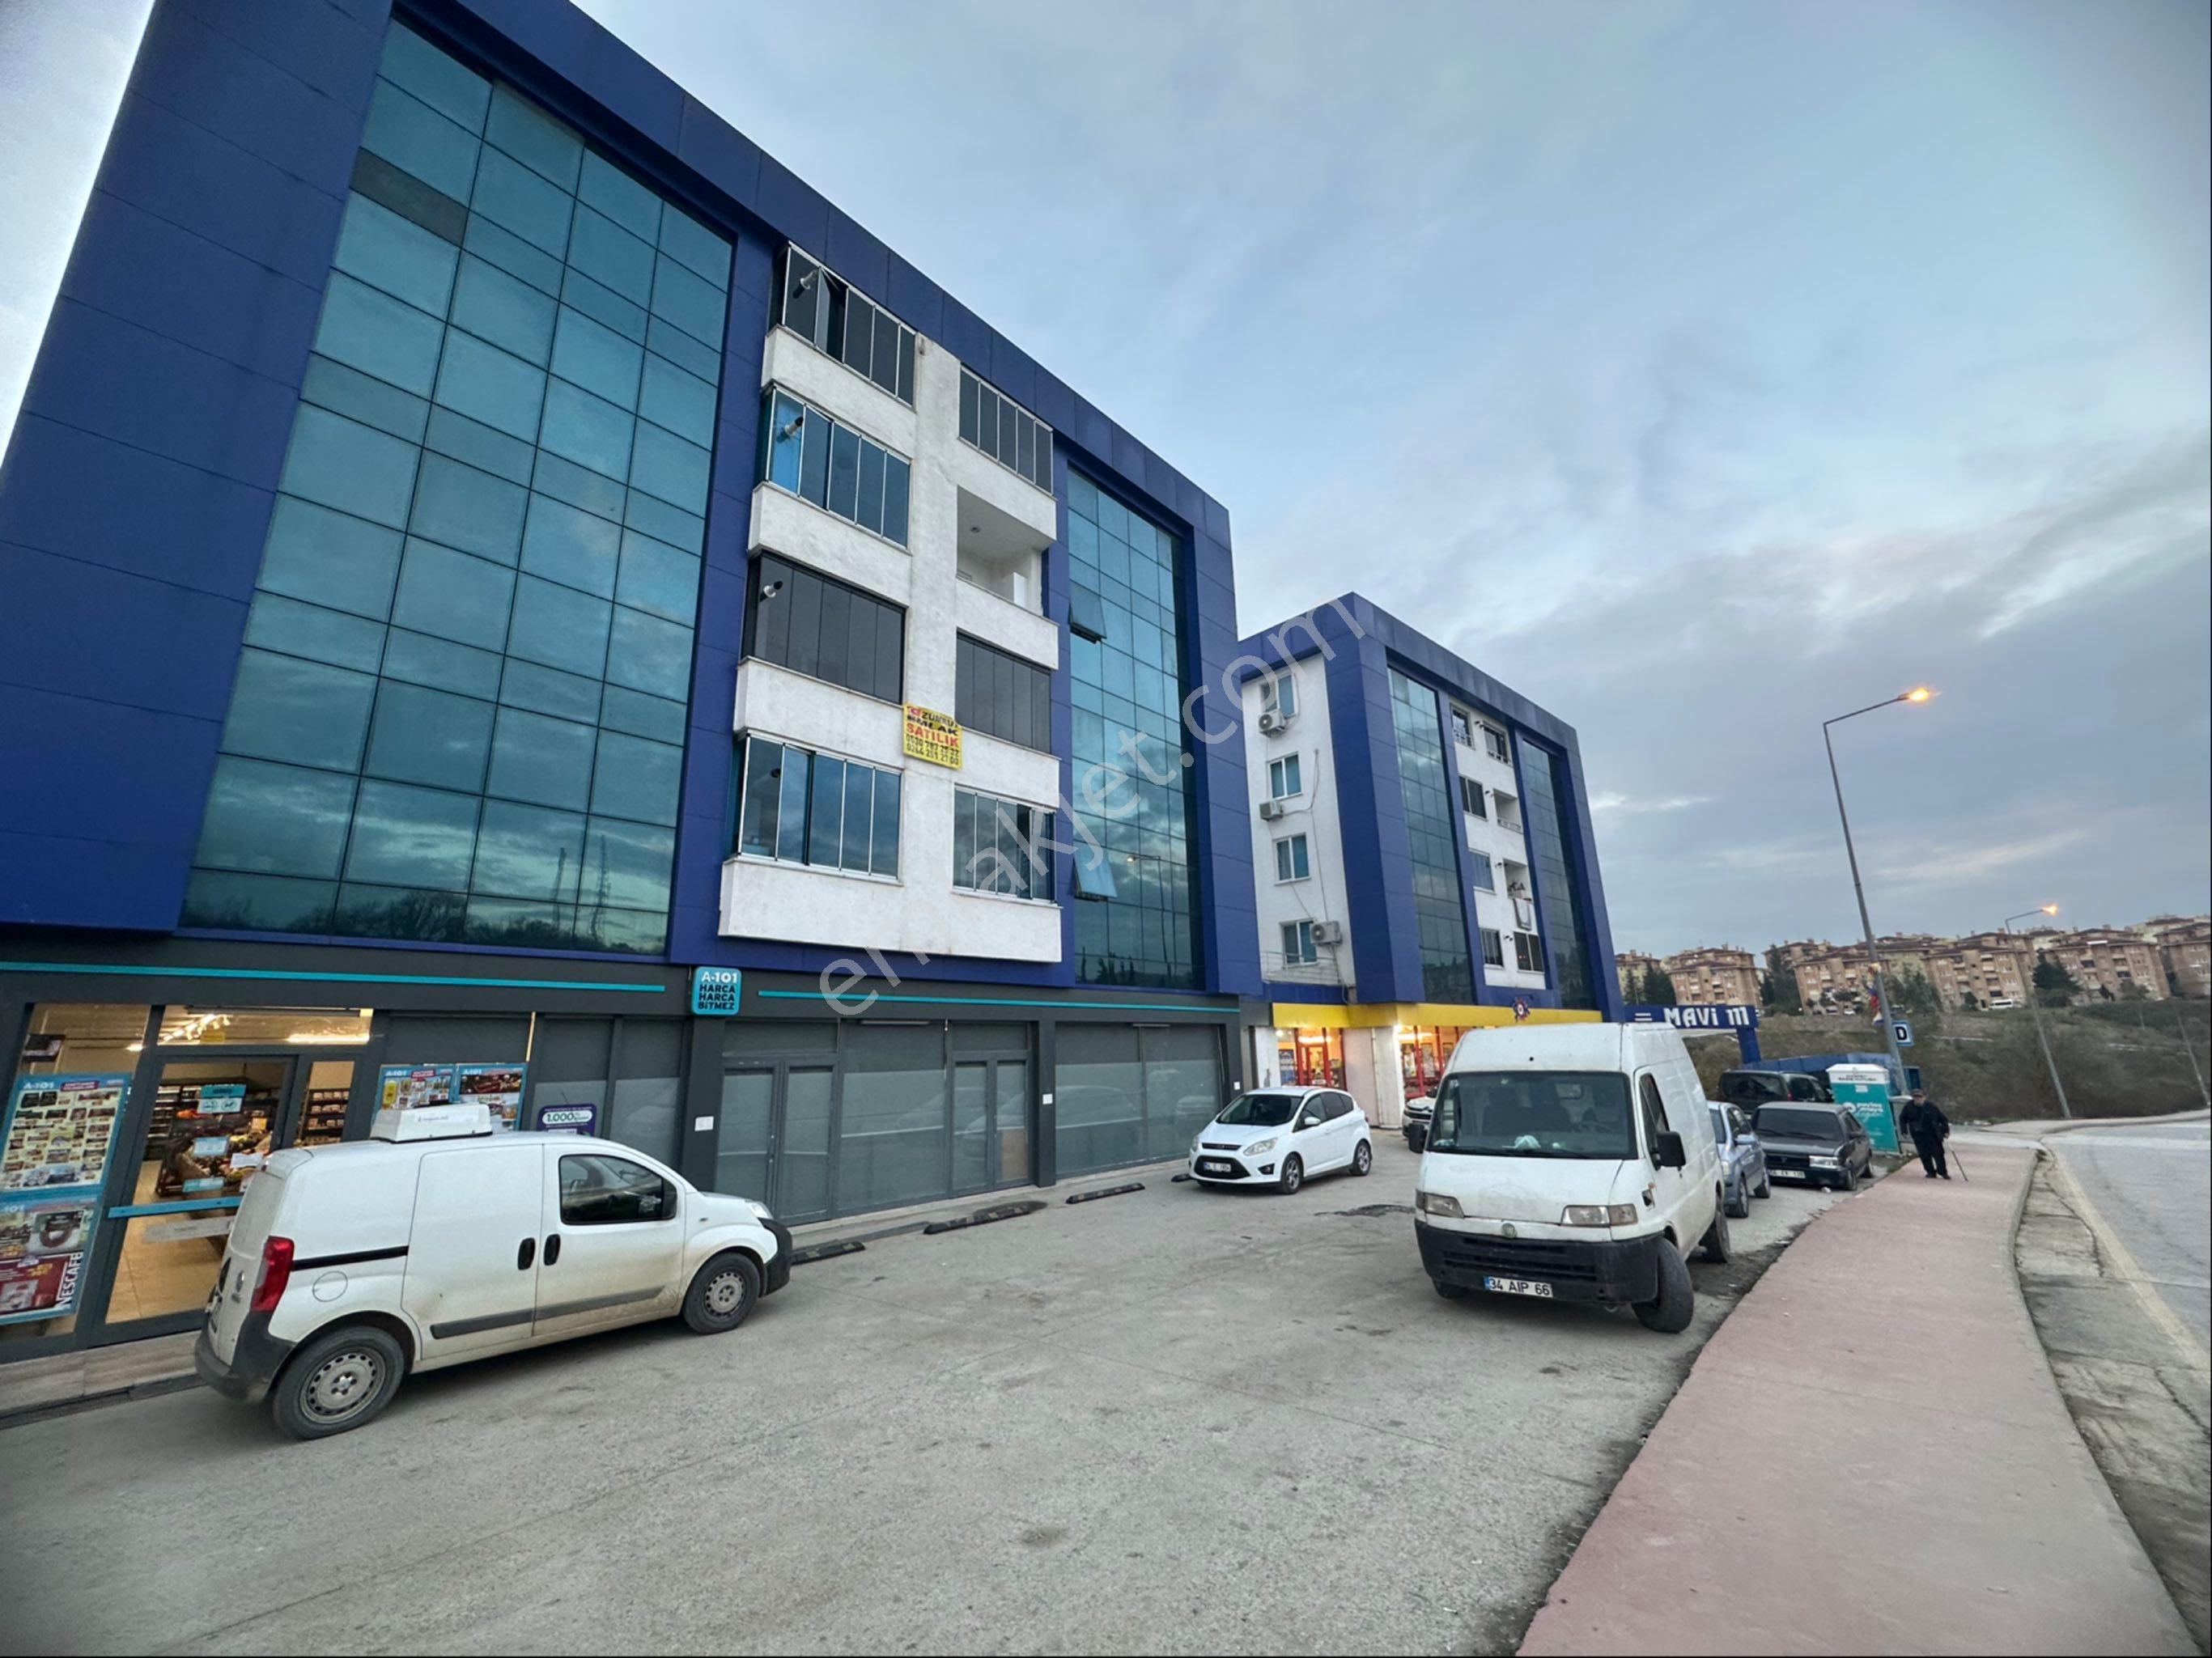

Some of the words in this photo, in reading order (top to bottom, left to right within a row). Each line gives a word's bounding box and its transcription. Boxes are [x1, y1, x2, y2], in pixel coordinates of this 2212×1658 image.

[906, 723, 958, 747] SATILIK
[699, 984, 736, 994] HARCA
[698, 993, 735, 1002] HARCA
[1895, 1026, 1908, 1041] D
[1489, 1278, 1504, 1291] 34
[1509, 1281, 1529, 1293] AIP
[1535, 1283, 1550, 1295] 66
